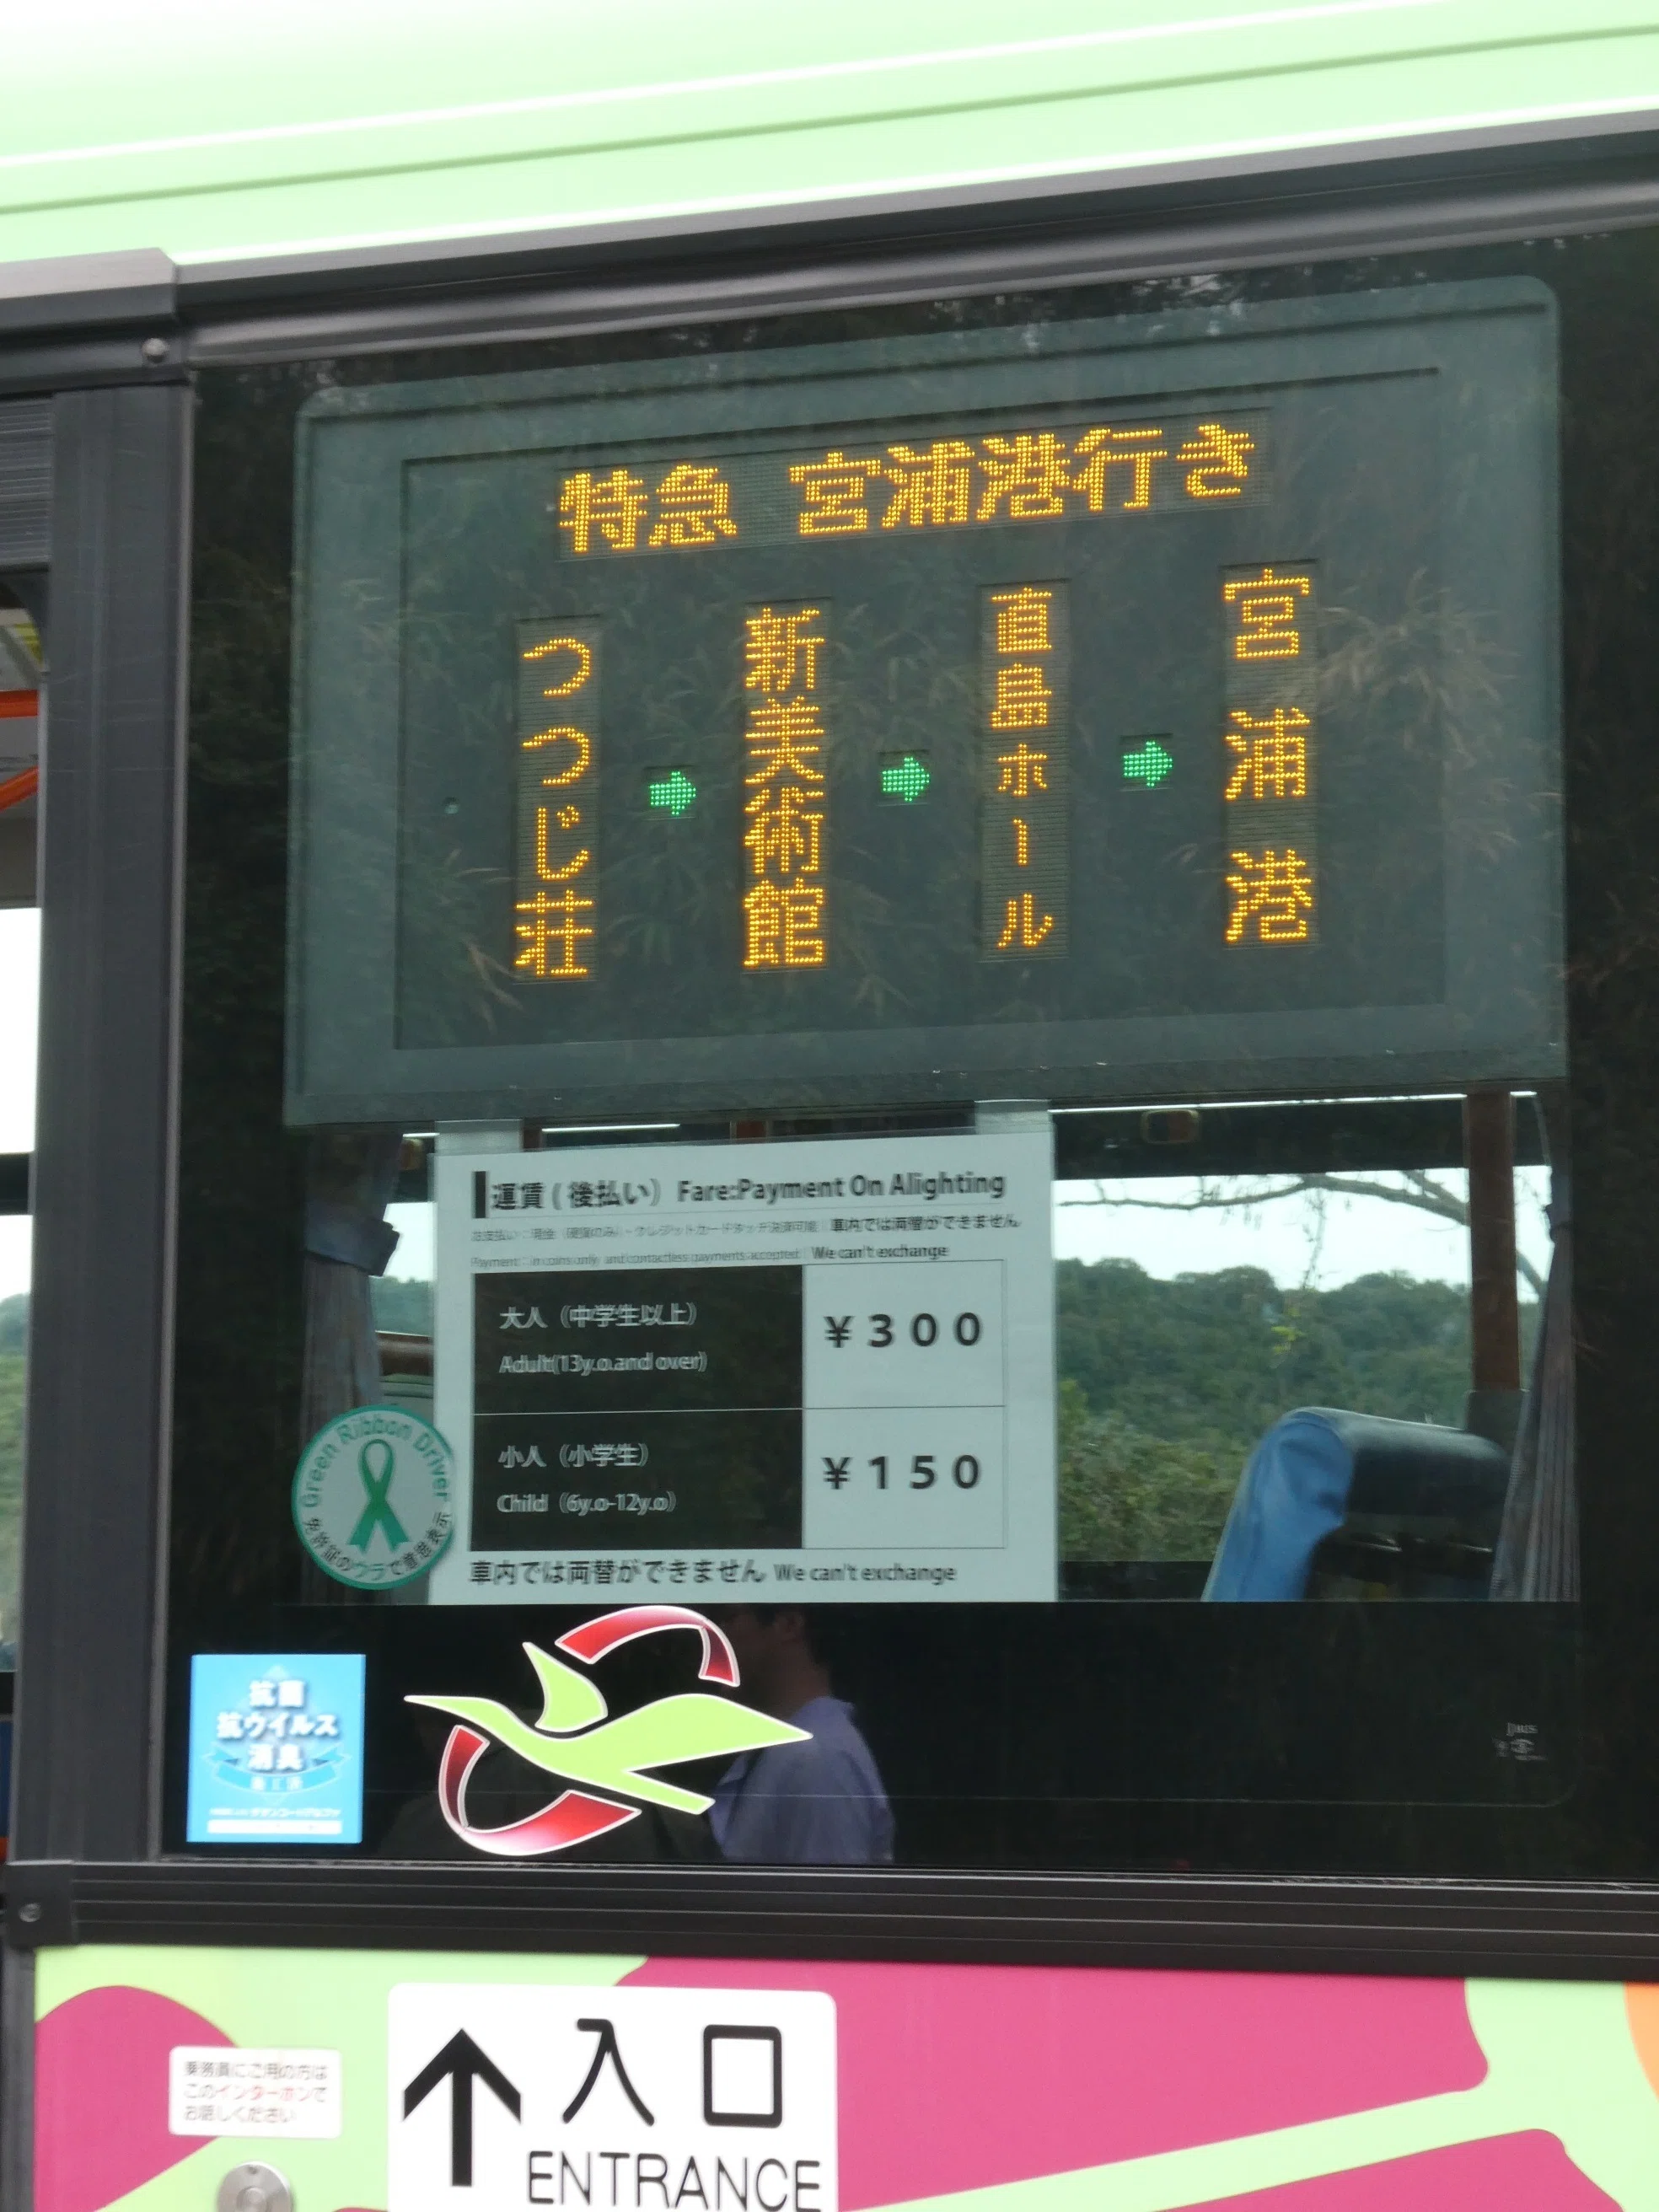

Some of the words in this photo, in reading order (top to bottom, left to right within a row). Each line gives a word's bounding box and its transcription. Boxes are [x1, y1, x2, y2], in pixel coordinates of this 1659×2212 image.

[558, 464, 738, 554] 特急
[789, 422, 1256, 536] 宮浦港行き
[515, 637, 593, 976] つつじ荘
[743, 607, 826, 969] 新美術館
[990, 587, 1054, 949] 直島ホール
[1223, 568, 1313, 942] 宮浦港
[850, 1173, 883, 1196] On
[889, 1171, 1007, 1200] Alighting
[812, 1246, 835, 1259] We
[878, 1243, 950, 1260] exchange
[301, 1442, 339, 1508] Green
[338, 1415, 412, 1444] Ribbon
[413, 1432, 450, 1498] Driver
[469, 1559, 766, 1585] 車内では両替ができません
[773, 1563, 805, 1582] We
[808, 1561, 857, 1582] can't
[860, 1561, 958, 1586] exchange
[562, 2018, 783, 2129] 入口
[528, 2150, 821, 2212] ENTRANCE
